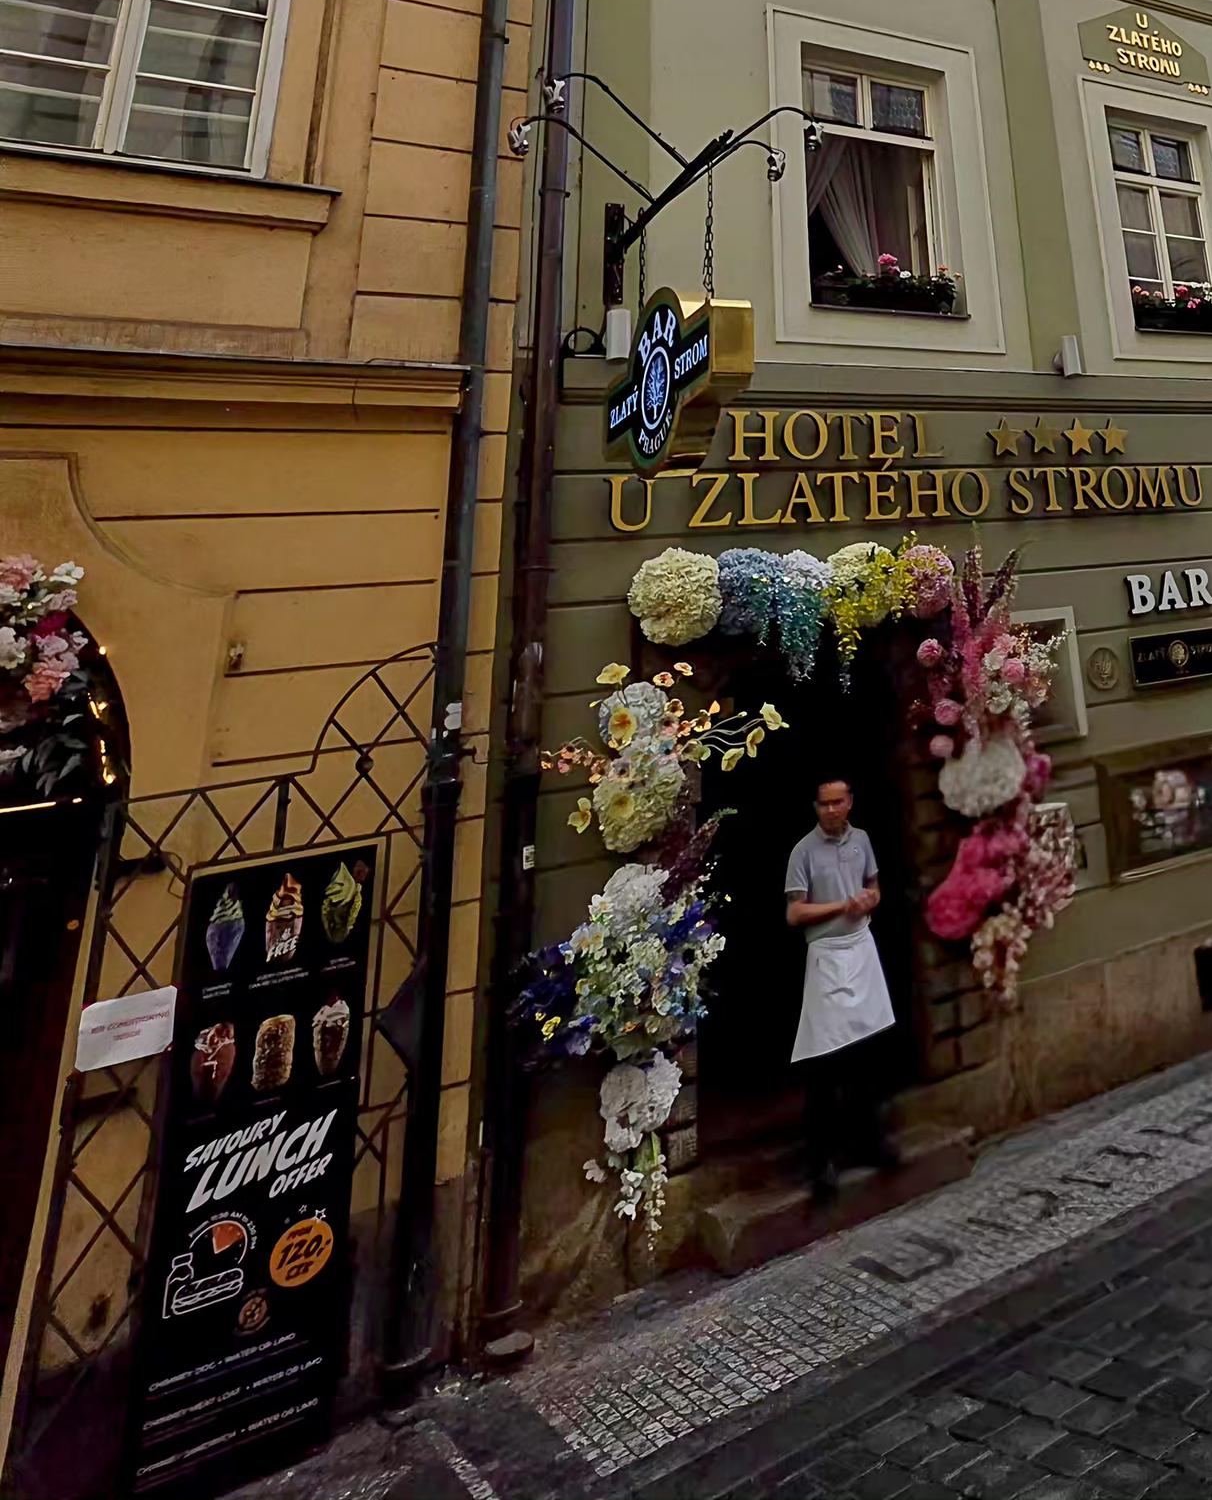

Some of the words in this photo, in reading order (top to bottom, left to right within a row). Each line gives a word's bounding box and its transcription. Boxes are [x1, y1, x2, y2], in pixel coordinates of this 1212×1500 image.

[1106, 24, 1183, 57] ZLATÉHO
[1135, 12, 1149, 29] U
[1116, 47, 1181, 77] STROMU
[637, 308, 677, 367] BAR
[610, 385, 639, 429] ZLATÝ
[674, 334, 708, 380] STROM
[726, 409, 945, 461] HOTEL
[605, 474, 657, 532] U
[688, 458, 990, 528] ZLATÉHO
[1008, 465, 1203, 515] STROMU
[265, 934, 299, 963] FREE
[183, 1110, 288, 1173] SAVOURY
[185, 1108, 338, 1213] LUNCH
[269, 1153, 334, 1198] OFFER
